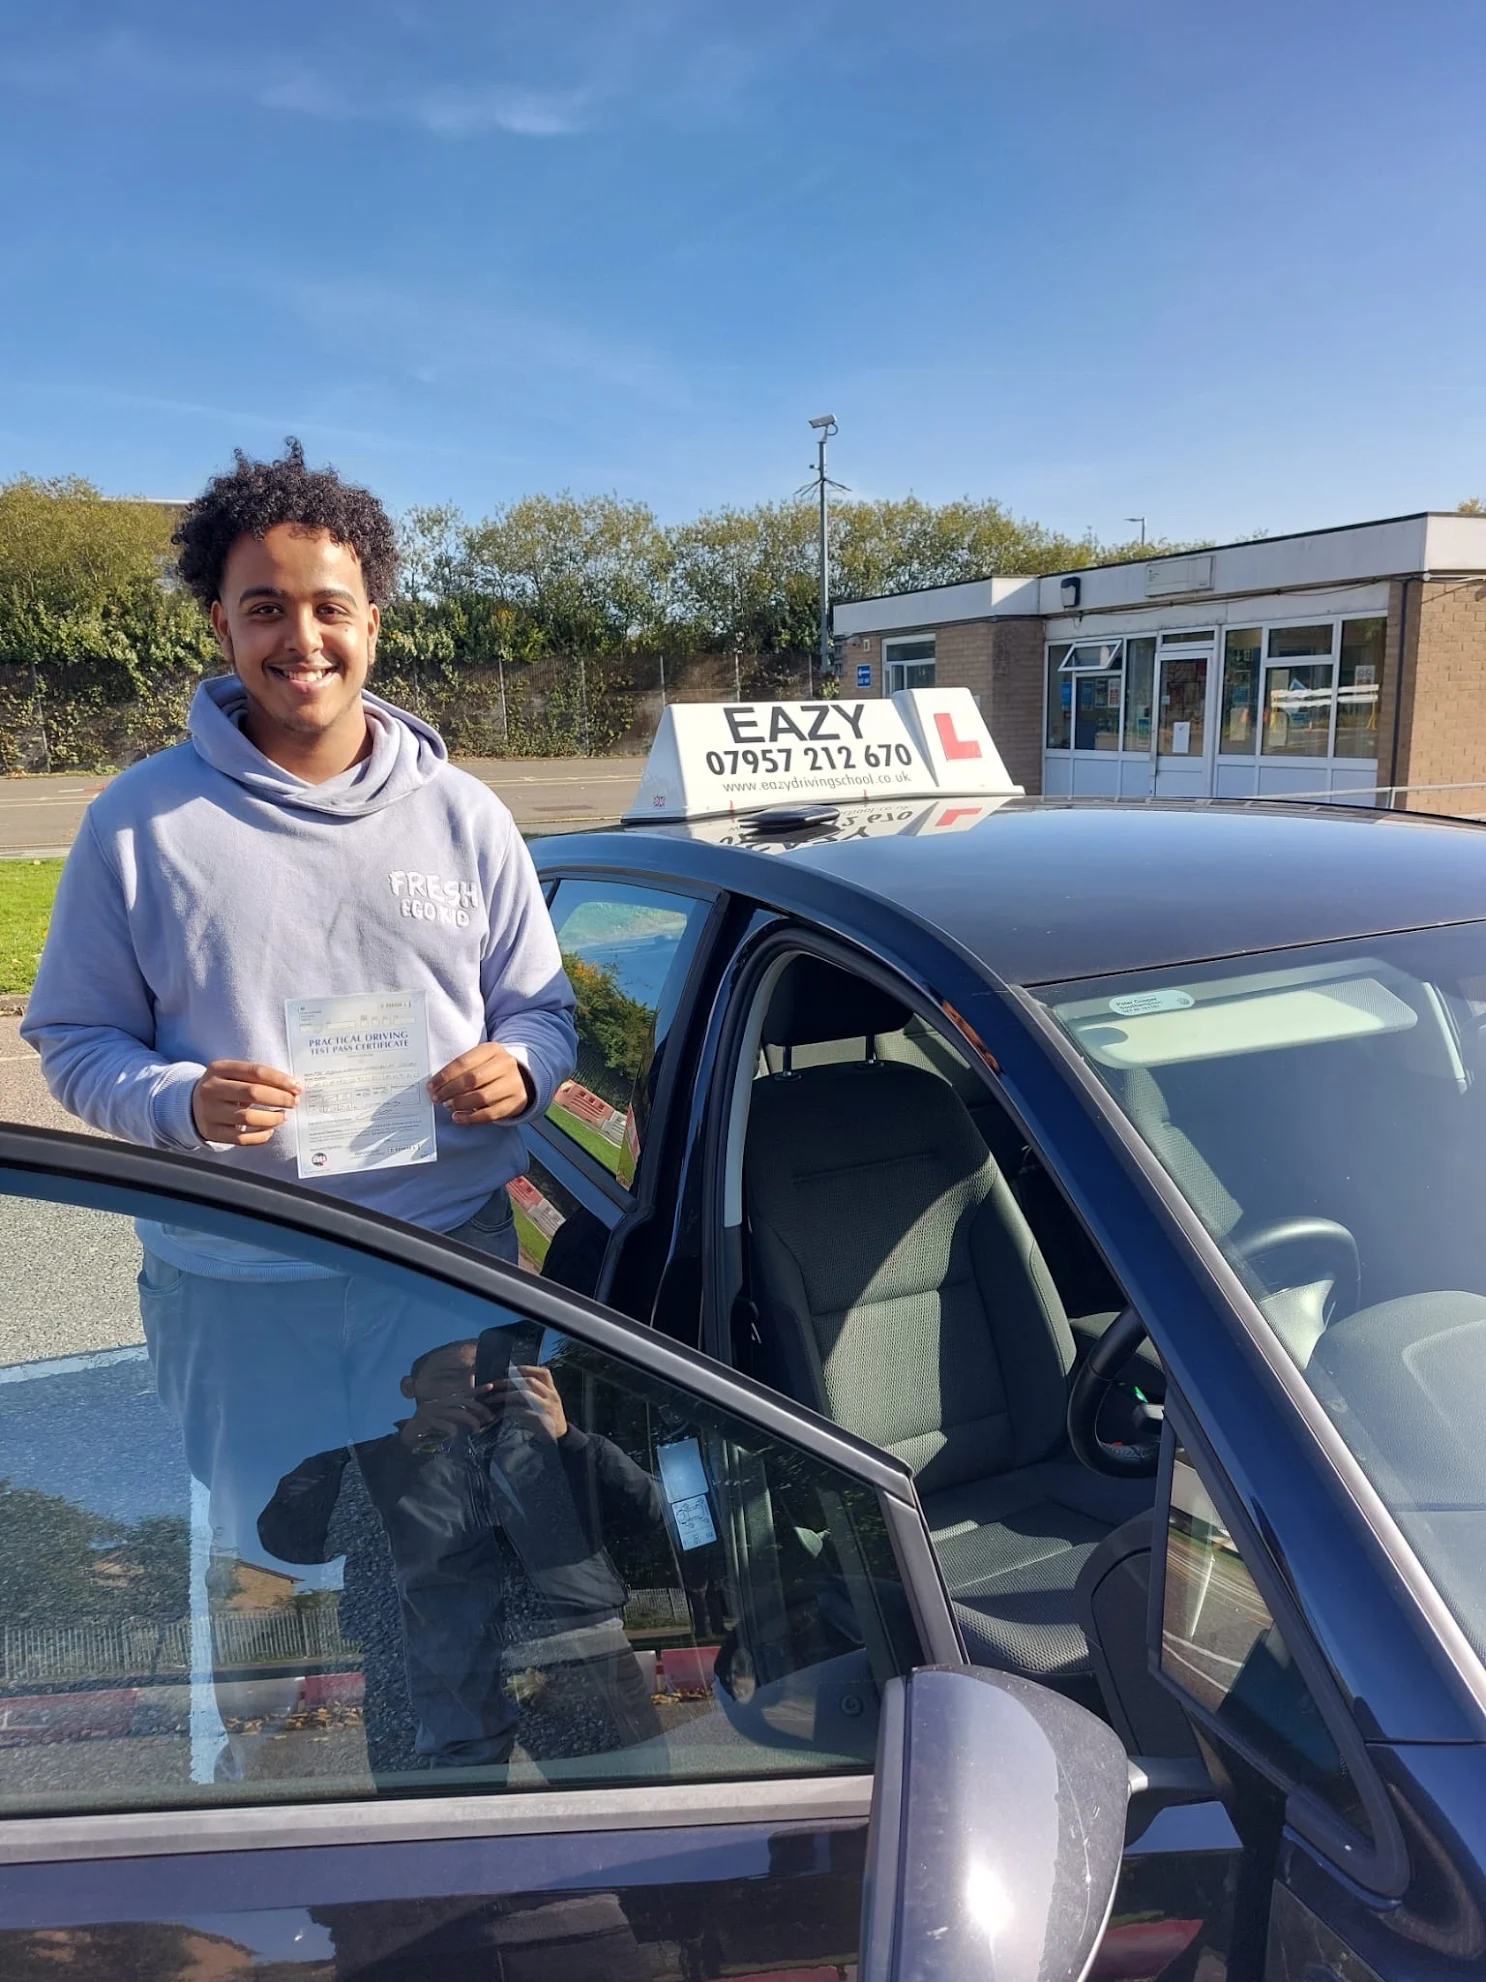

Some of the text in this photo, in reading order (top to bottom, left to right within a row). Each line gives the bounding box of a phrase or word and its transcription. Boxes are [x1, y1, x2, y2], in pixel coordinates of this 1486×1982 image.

[723, 703, 866, 744] EAZY
[933, 712, 982, 761] L
[706, 743, 912, 776] 07957 212 670
[722, 770, 912, 793] www.eazydrivingschool.co.uk
[388, 870, 479, 909] FRESH
[309, 1030, 409, 1047] PRACTICAL DRIVING
[310, 1040, 409, 1055] TEST PASS CERTIFICATE
